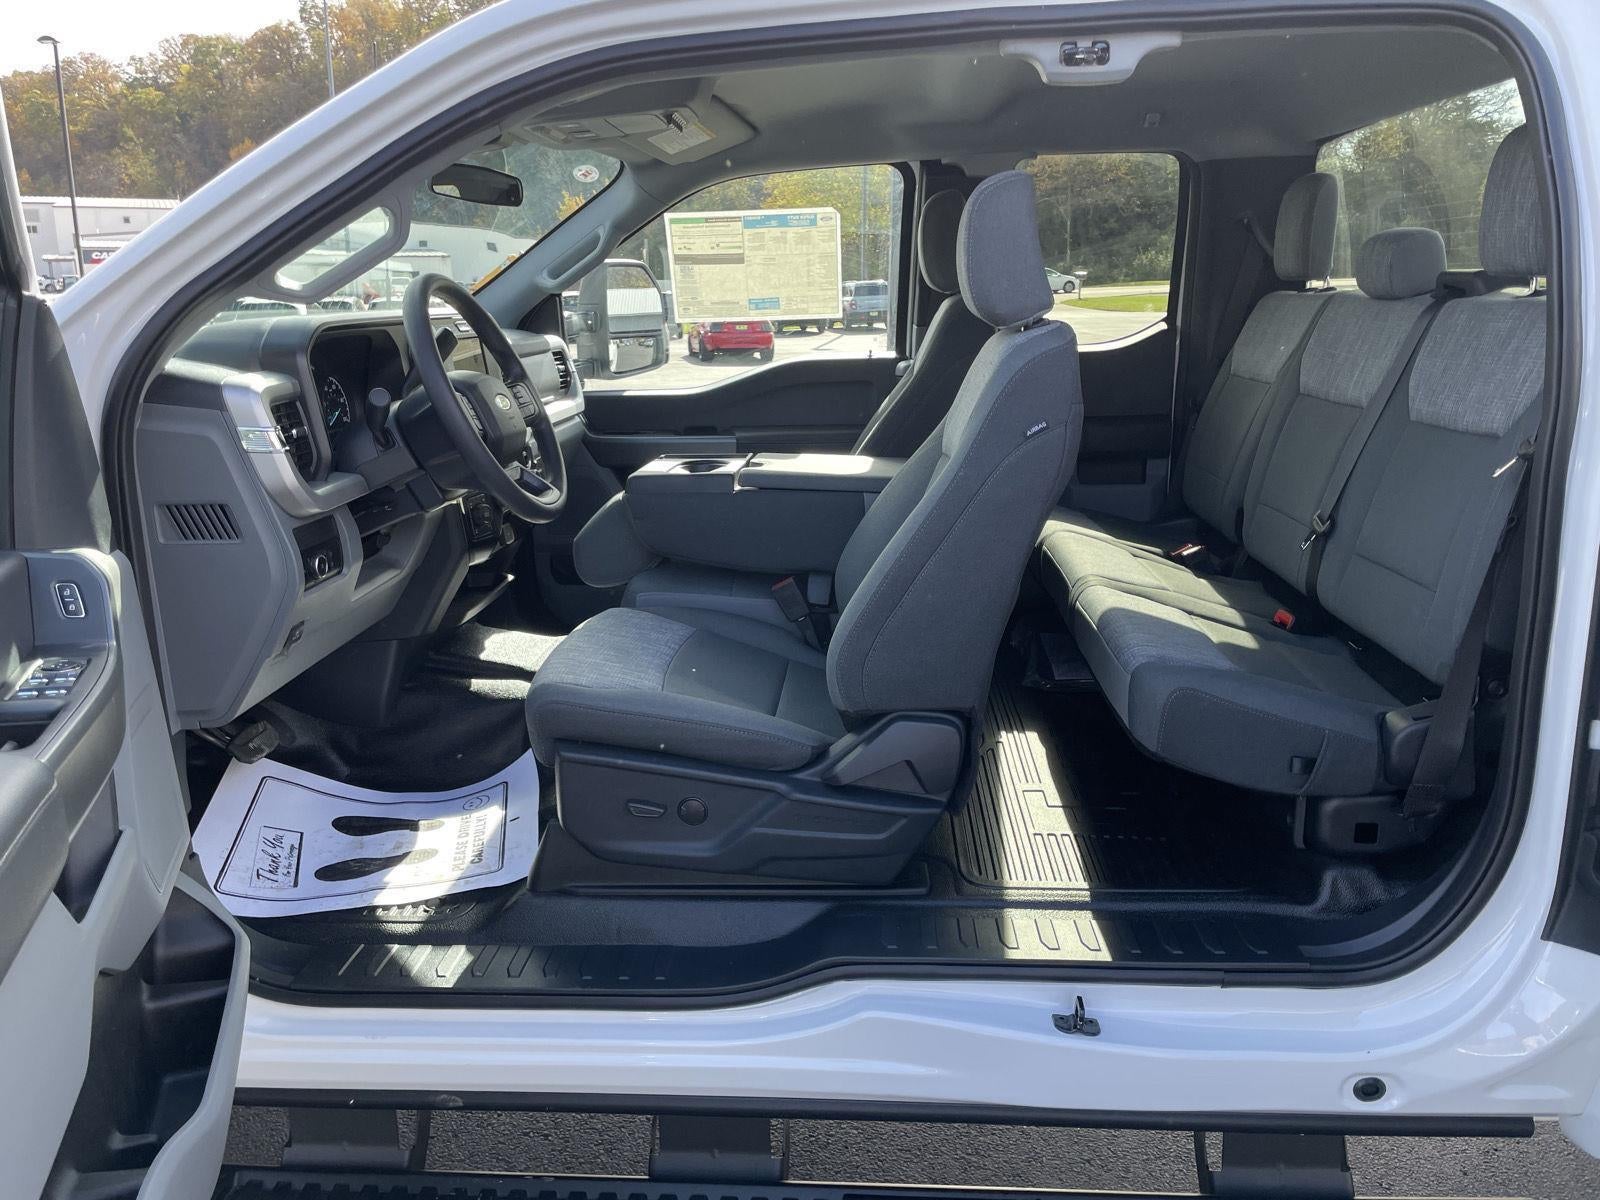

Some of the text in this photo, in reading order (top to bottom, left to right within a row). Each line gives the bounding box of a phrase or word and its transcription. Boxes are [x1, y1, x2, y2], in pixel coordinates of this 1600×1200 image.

[1026, 421, 1047, 437] AIRBAG
[256, 833, 285, 883] Thank You
[452, 814, 472, 872] PLEASE DRIVE
[469, 813, 487, 865] CAREFULLY!
